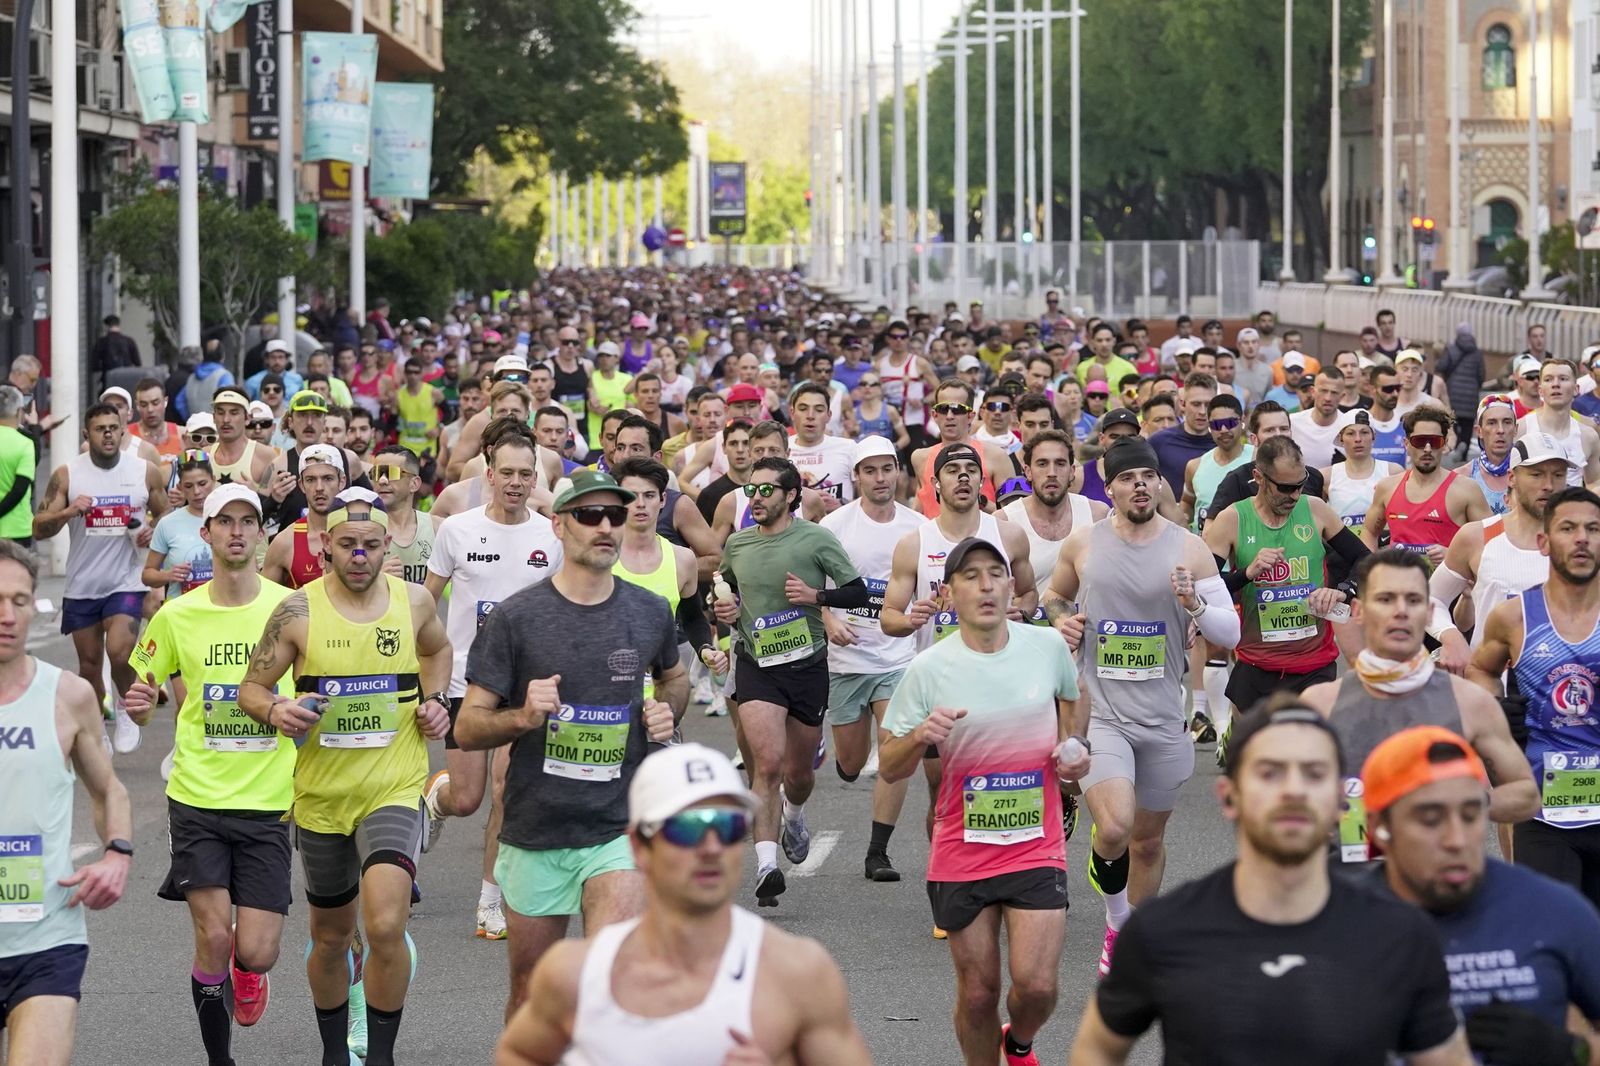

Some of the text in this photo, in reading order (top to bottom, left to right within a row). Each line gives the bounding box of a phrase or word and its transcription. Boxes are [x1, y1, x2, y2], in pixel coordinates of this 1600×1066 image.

[93, 517, 124, 526] MIGUEL
[467, 552, 500, 562] Hugo
[1254, 556, 1309, 583] ADN
[1278, 587, 1310, 598] ZURICH
[769, 610, 799, 625] ZURICH
[1121, 624, 1158, 634] ZURICH
[761, 634, 807, 656] RODRIGO
[1122, 642, 1142, 651] 2857
[1104, 653, 1158, 667] MR PAID.
[346, 680, 389, 692] ZURICH
[347, 702, 370, 713] 2503
[578, 710, 622, 721] ZURICH
[337, 715, 381, 731] RICAR
[578, 732, 602, 742] 2754
[547, 743, 624, 763] TOM POUSS
[992, 775, 1035, 787] ZURICH
[1572, 777, 1596, 787] 2908
[993, 798, 1017, 808] 2717
[1543, 795, 1569, 806] JOSE
[968, 810, 1040, 828] FRANCOIS
